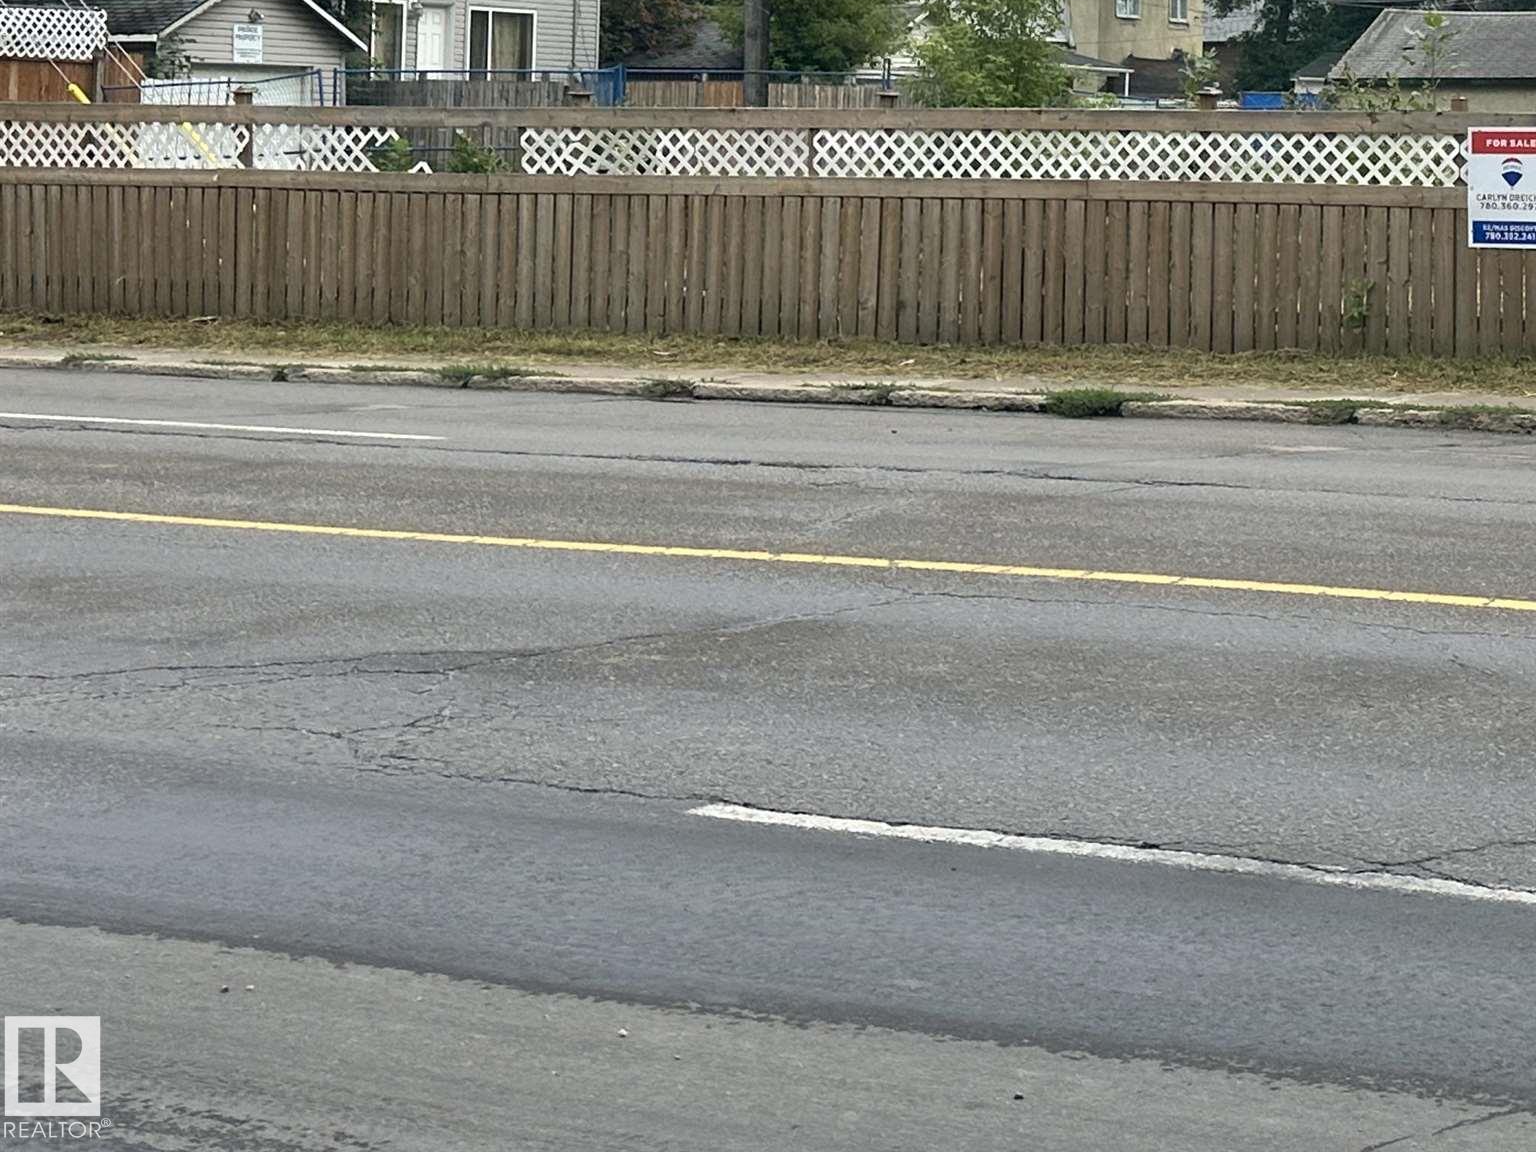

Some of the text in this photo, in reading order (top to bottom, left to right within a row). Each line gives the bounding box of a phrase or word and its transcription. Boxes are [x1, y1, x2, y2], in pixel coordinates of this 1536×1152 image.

[1486, 139, 1536, 148] FOR SALE
[1476, 193, 1507, 202] CARLYN
